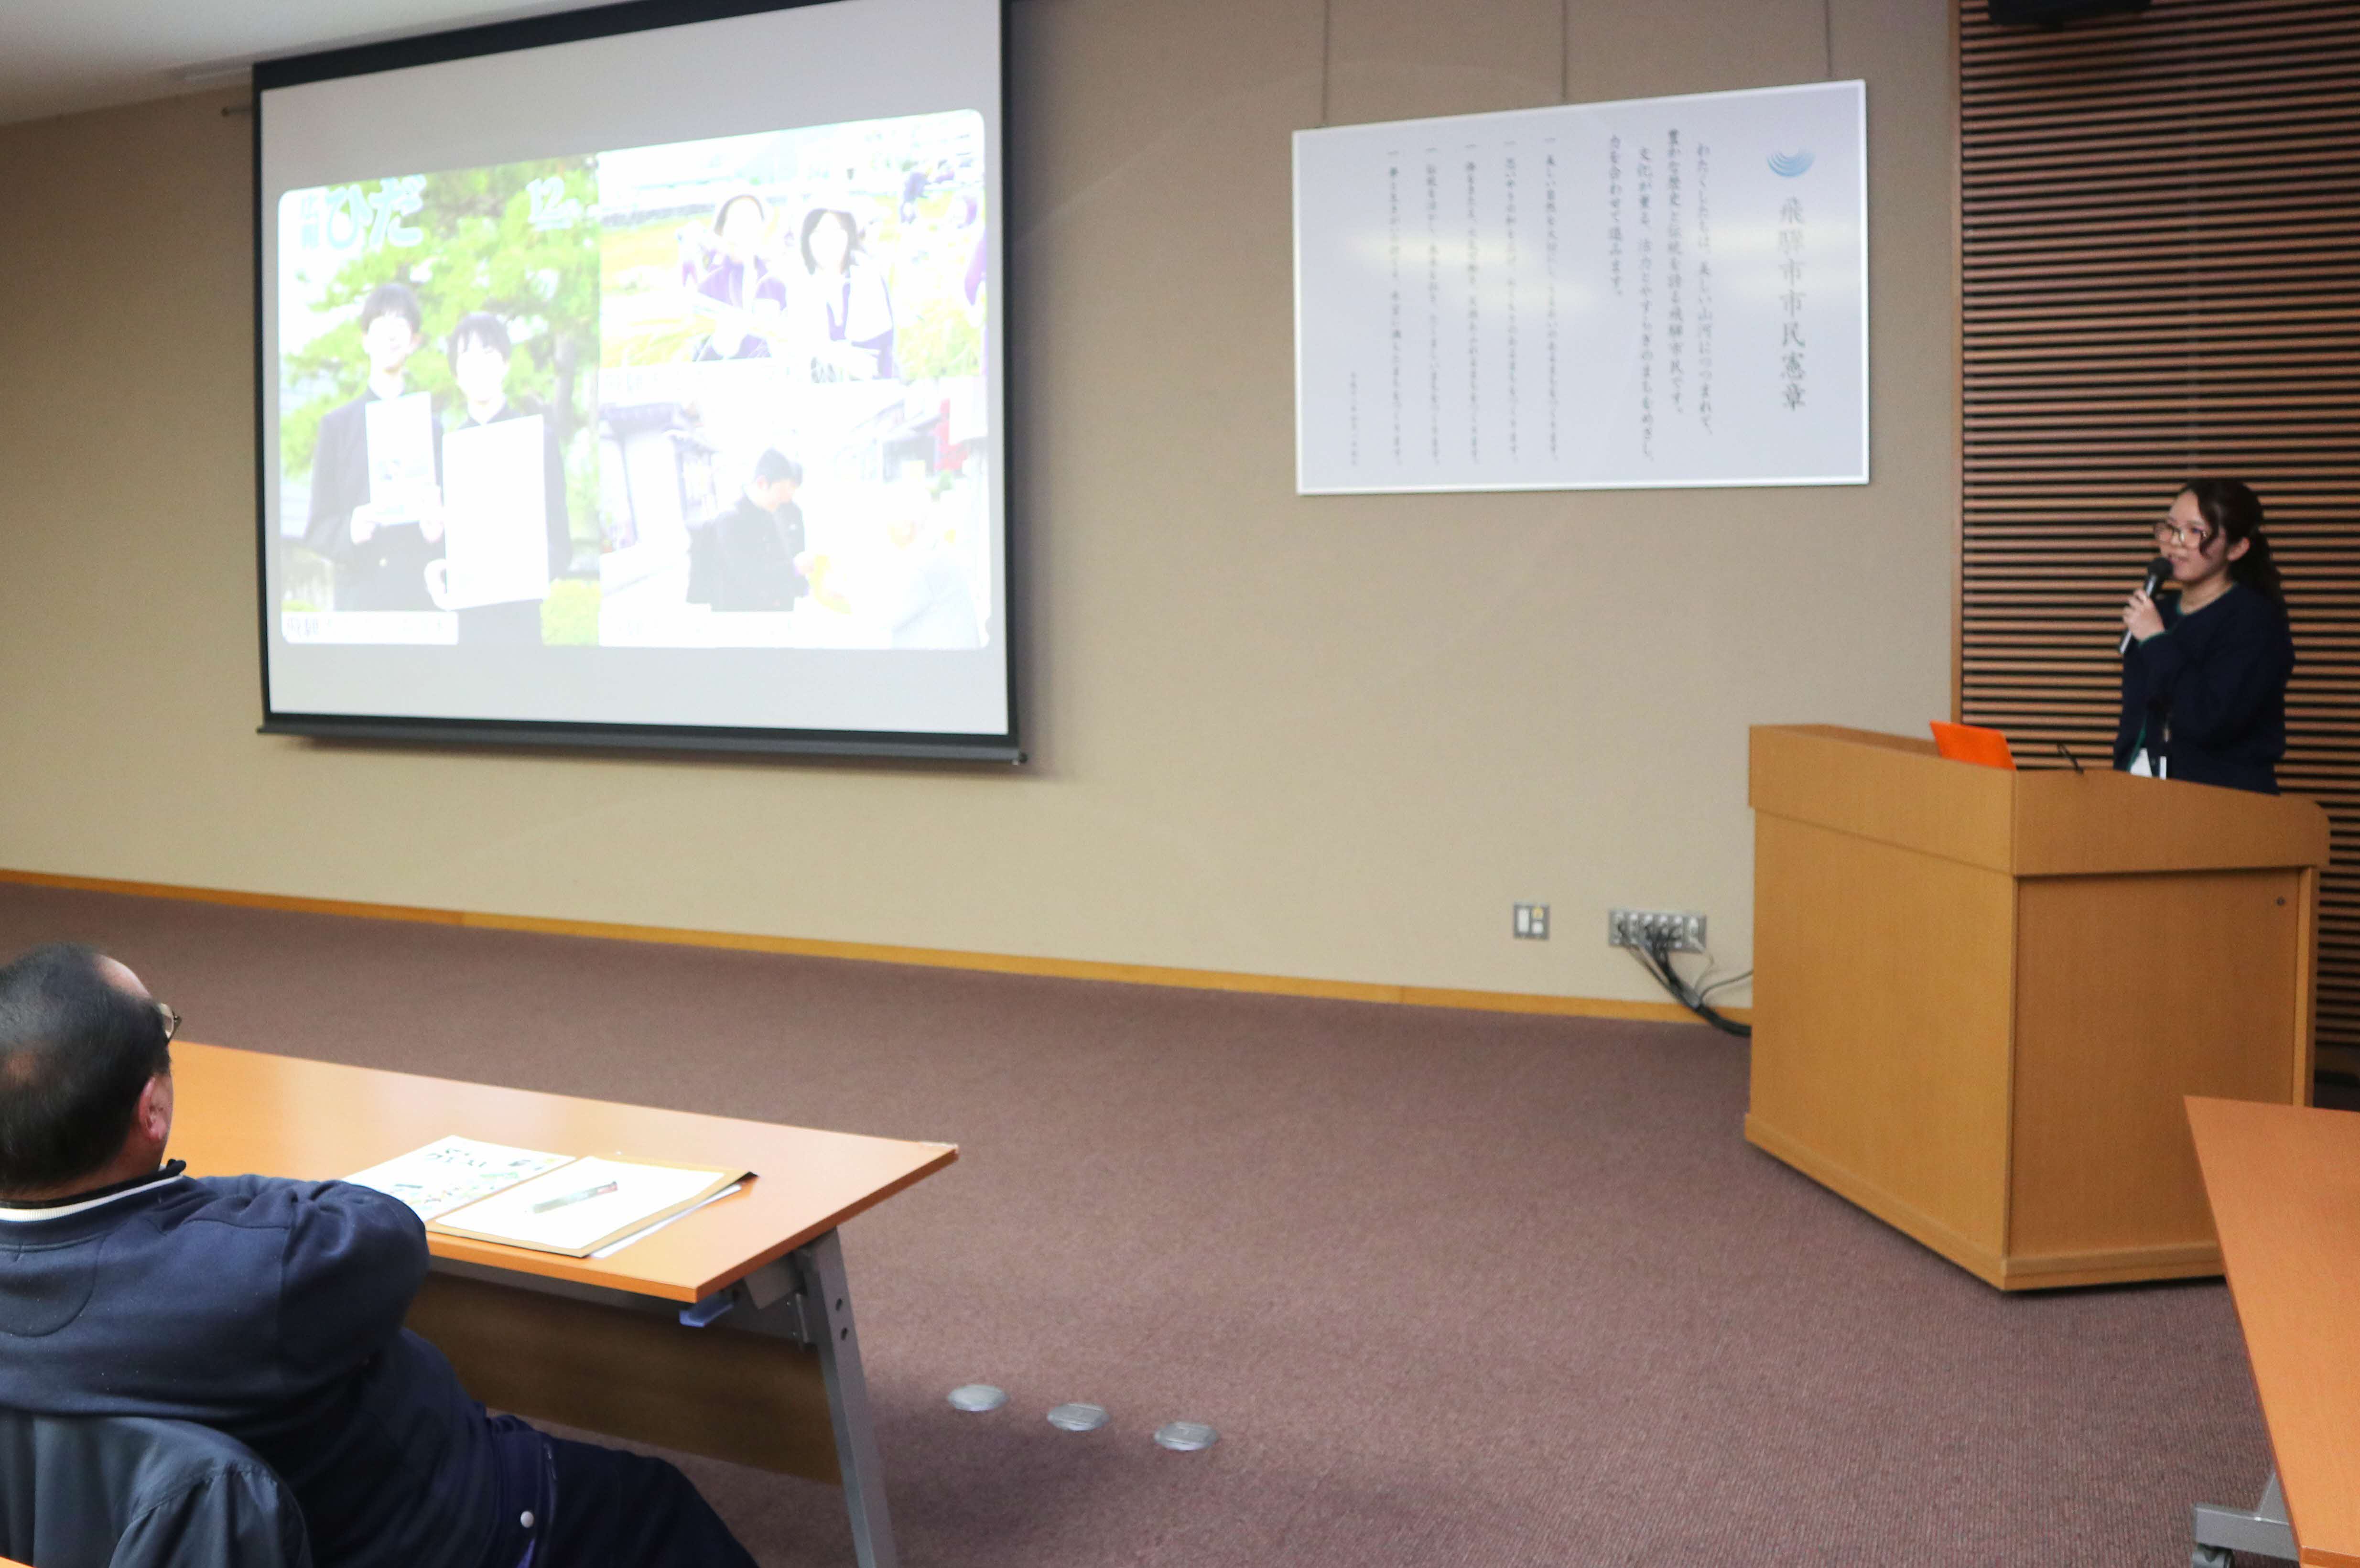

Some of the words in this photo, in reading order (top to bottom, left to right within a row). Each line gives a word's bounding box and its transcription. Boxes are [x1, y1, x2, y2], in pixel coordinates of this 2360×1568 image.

[324, 173, 427, 253] ひだ
[1779, 197, 1806, 411] 飛騨市市民憲章
